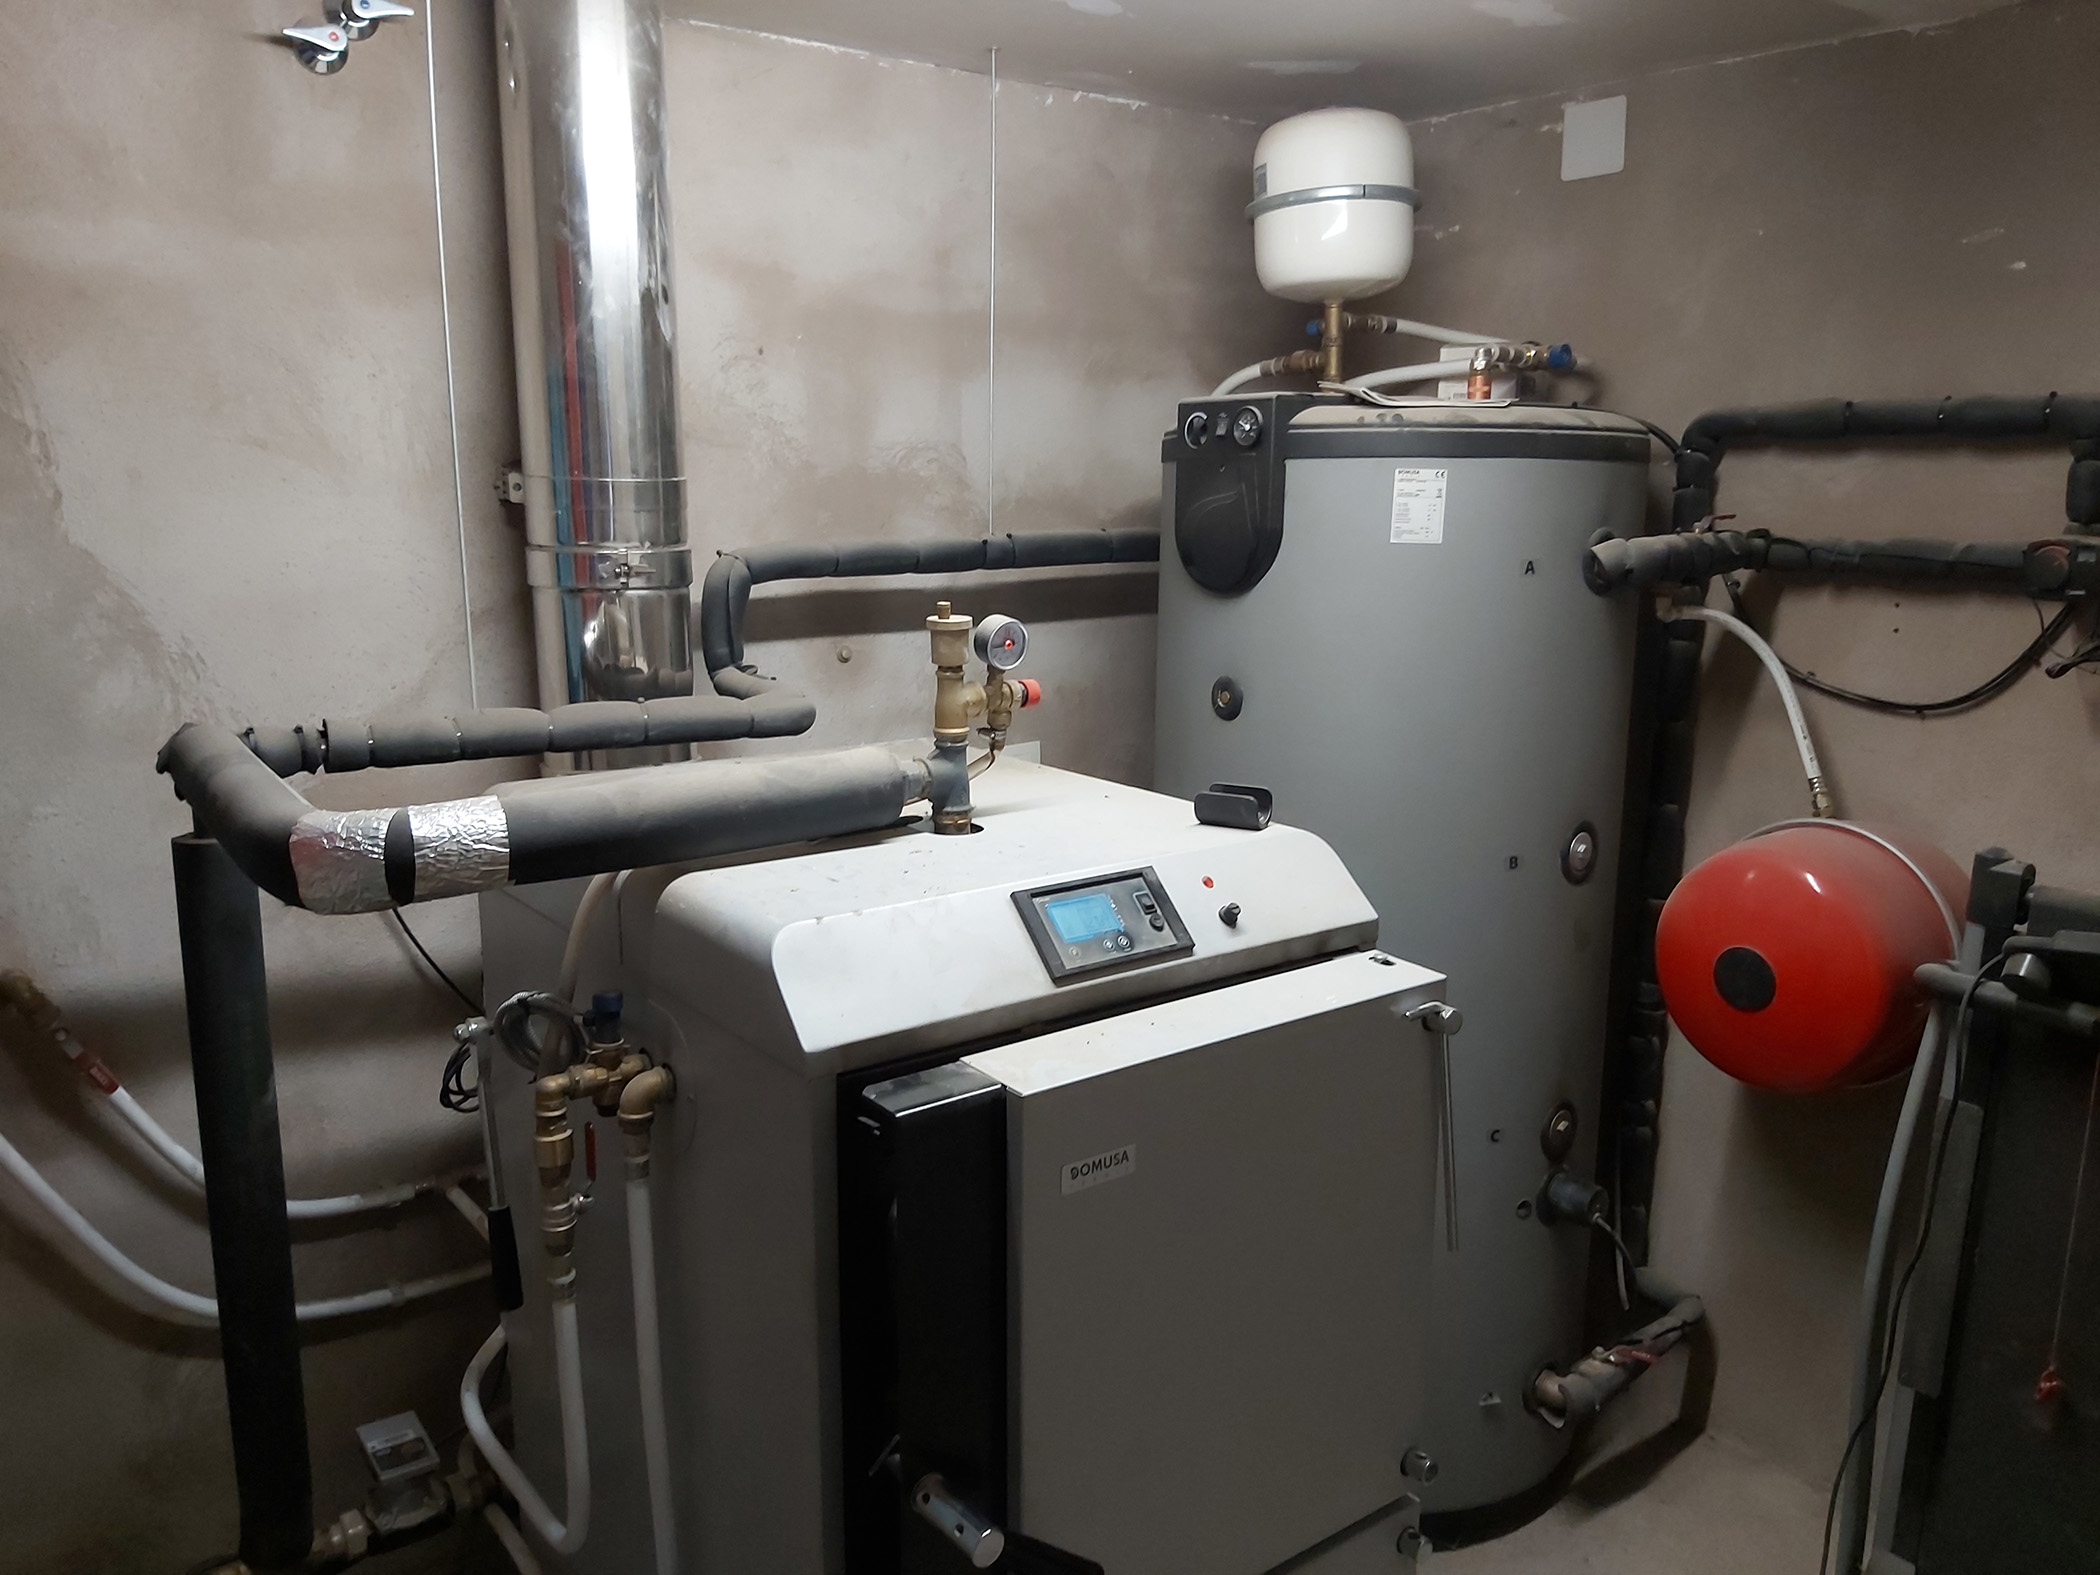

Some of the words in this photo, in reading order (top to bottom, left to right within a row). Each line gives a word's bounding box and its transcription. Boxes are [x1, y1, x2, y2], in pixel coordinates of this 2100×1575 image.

[1524, 561, 1535, 575] A
[1509, 856, 1517, 870] B
[1490, 1129, 1500, 1143] C
[1070, 1150, 1129, 1180] DOMUSA
